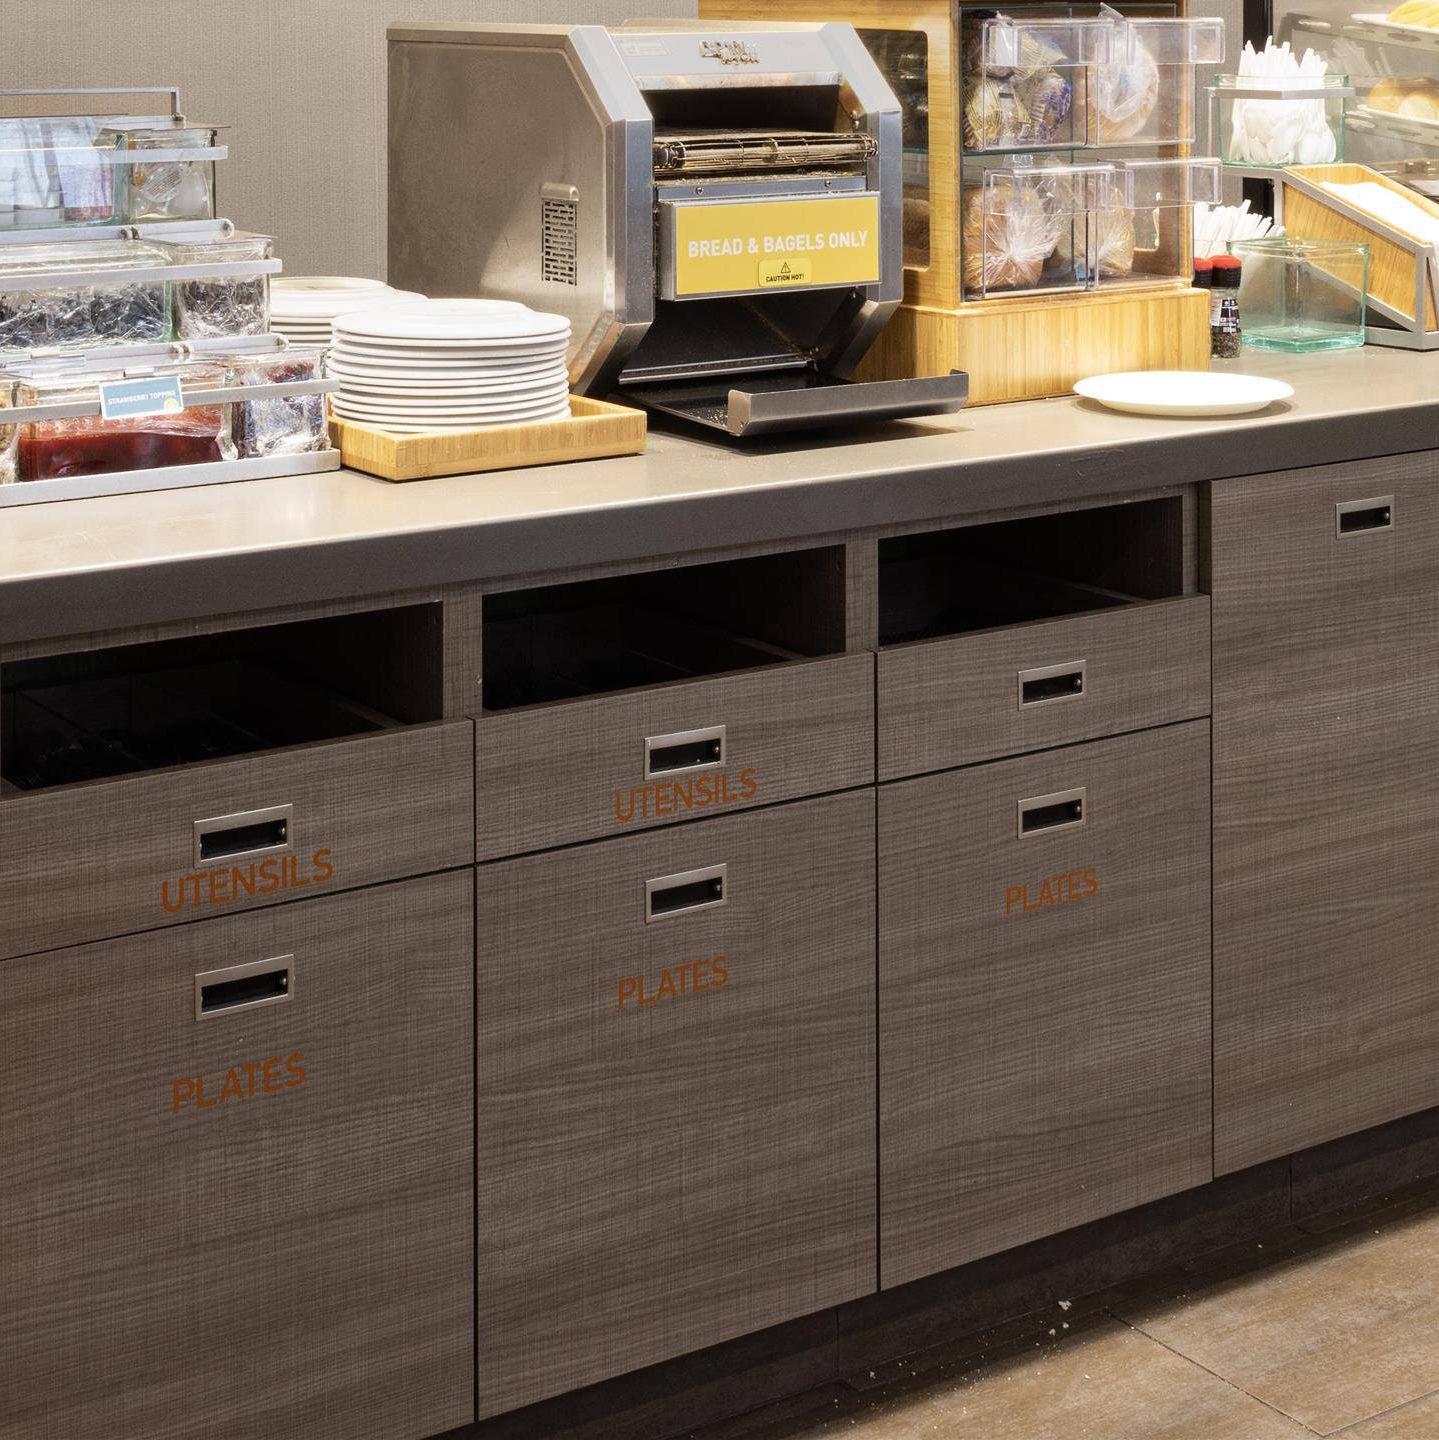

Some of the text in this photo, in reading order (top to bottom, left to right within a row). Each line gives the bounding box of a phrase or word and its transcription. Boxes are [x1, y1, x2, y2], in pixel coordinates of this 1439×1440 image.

[688, 230, 868, 258] BREAD & BAGELS ONLY
[766, 273, 805, 282] CAUTION HOT!
[614, 767, 759, 822] UTENSILS
[161, 847, 334, 912] UTENSILS
[1006, 866, 1100, 913] PLATES
[617, 954, 730, 1009] PLATES
[171, 1051, 307, 1116] PLATES
